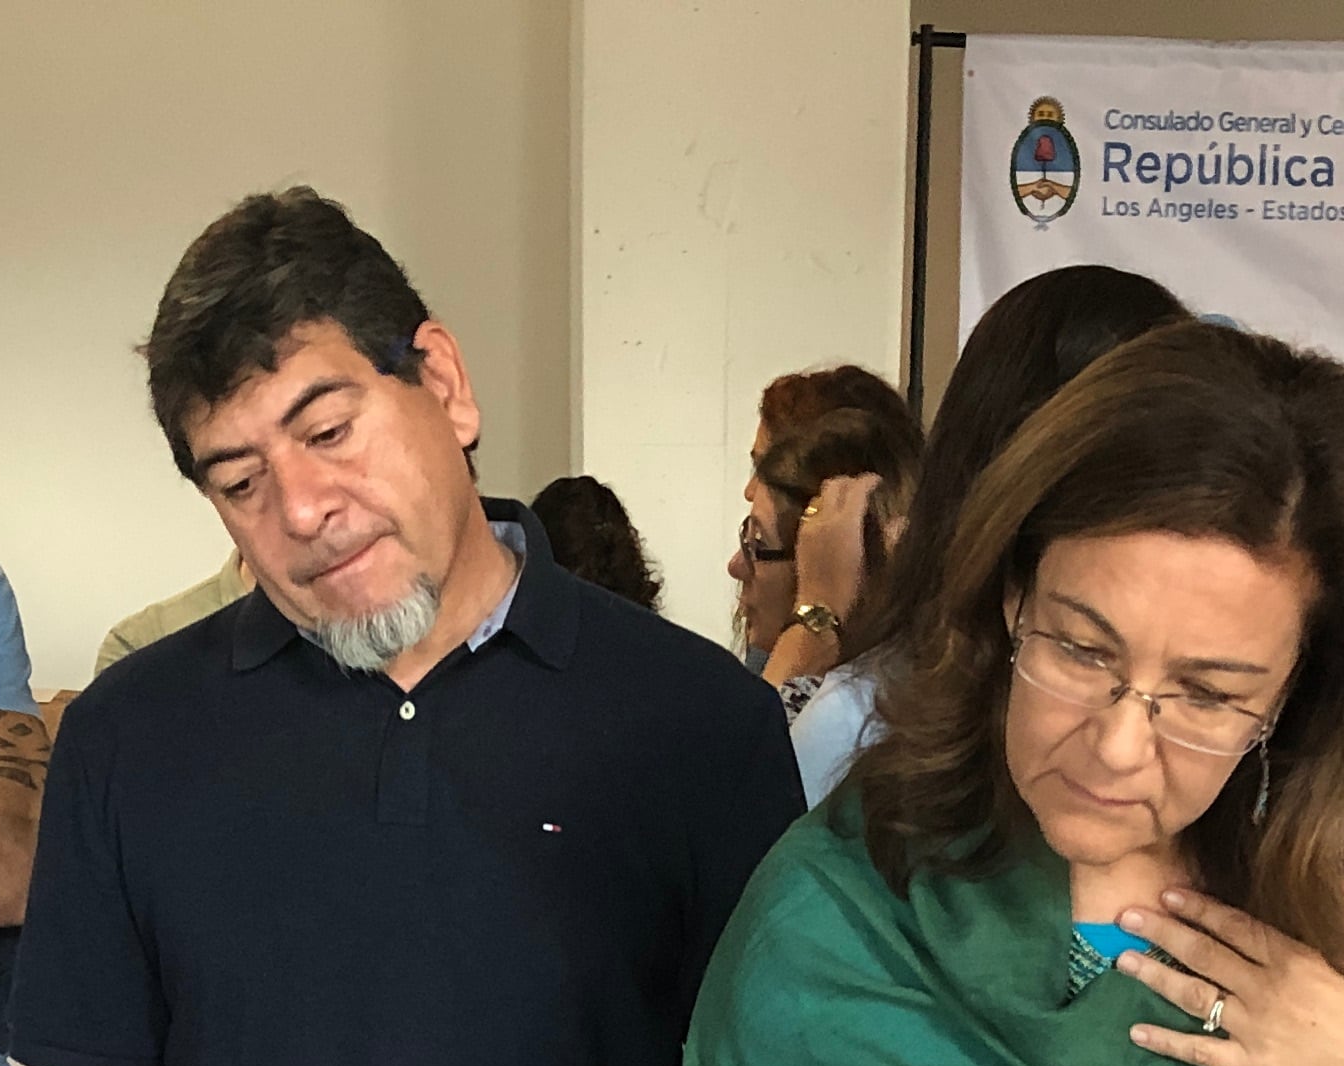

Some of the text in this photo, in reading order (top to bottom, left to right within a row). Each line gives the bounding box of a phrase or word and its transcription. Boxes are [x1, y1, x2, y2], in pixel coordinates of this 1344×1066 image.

[1104, 108, 1214, 132] Consulado
[1219, 112, 1296, 134] General
[1300, 119, 1312, 138] y
[1102, 141, 1334, 192] República
[1102, 196, 1140, 216] Los
[1146, 198, 1238, 222] Angeles
